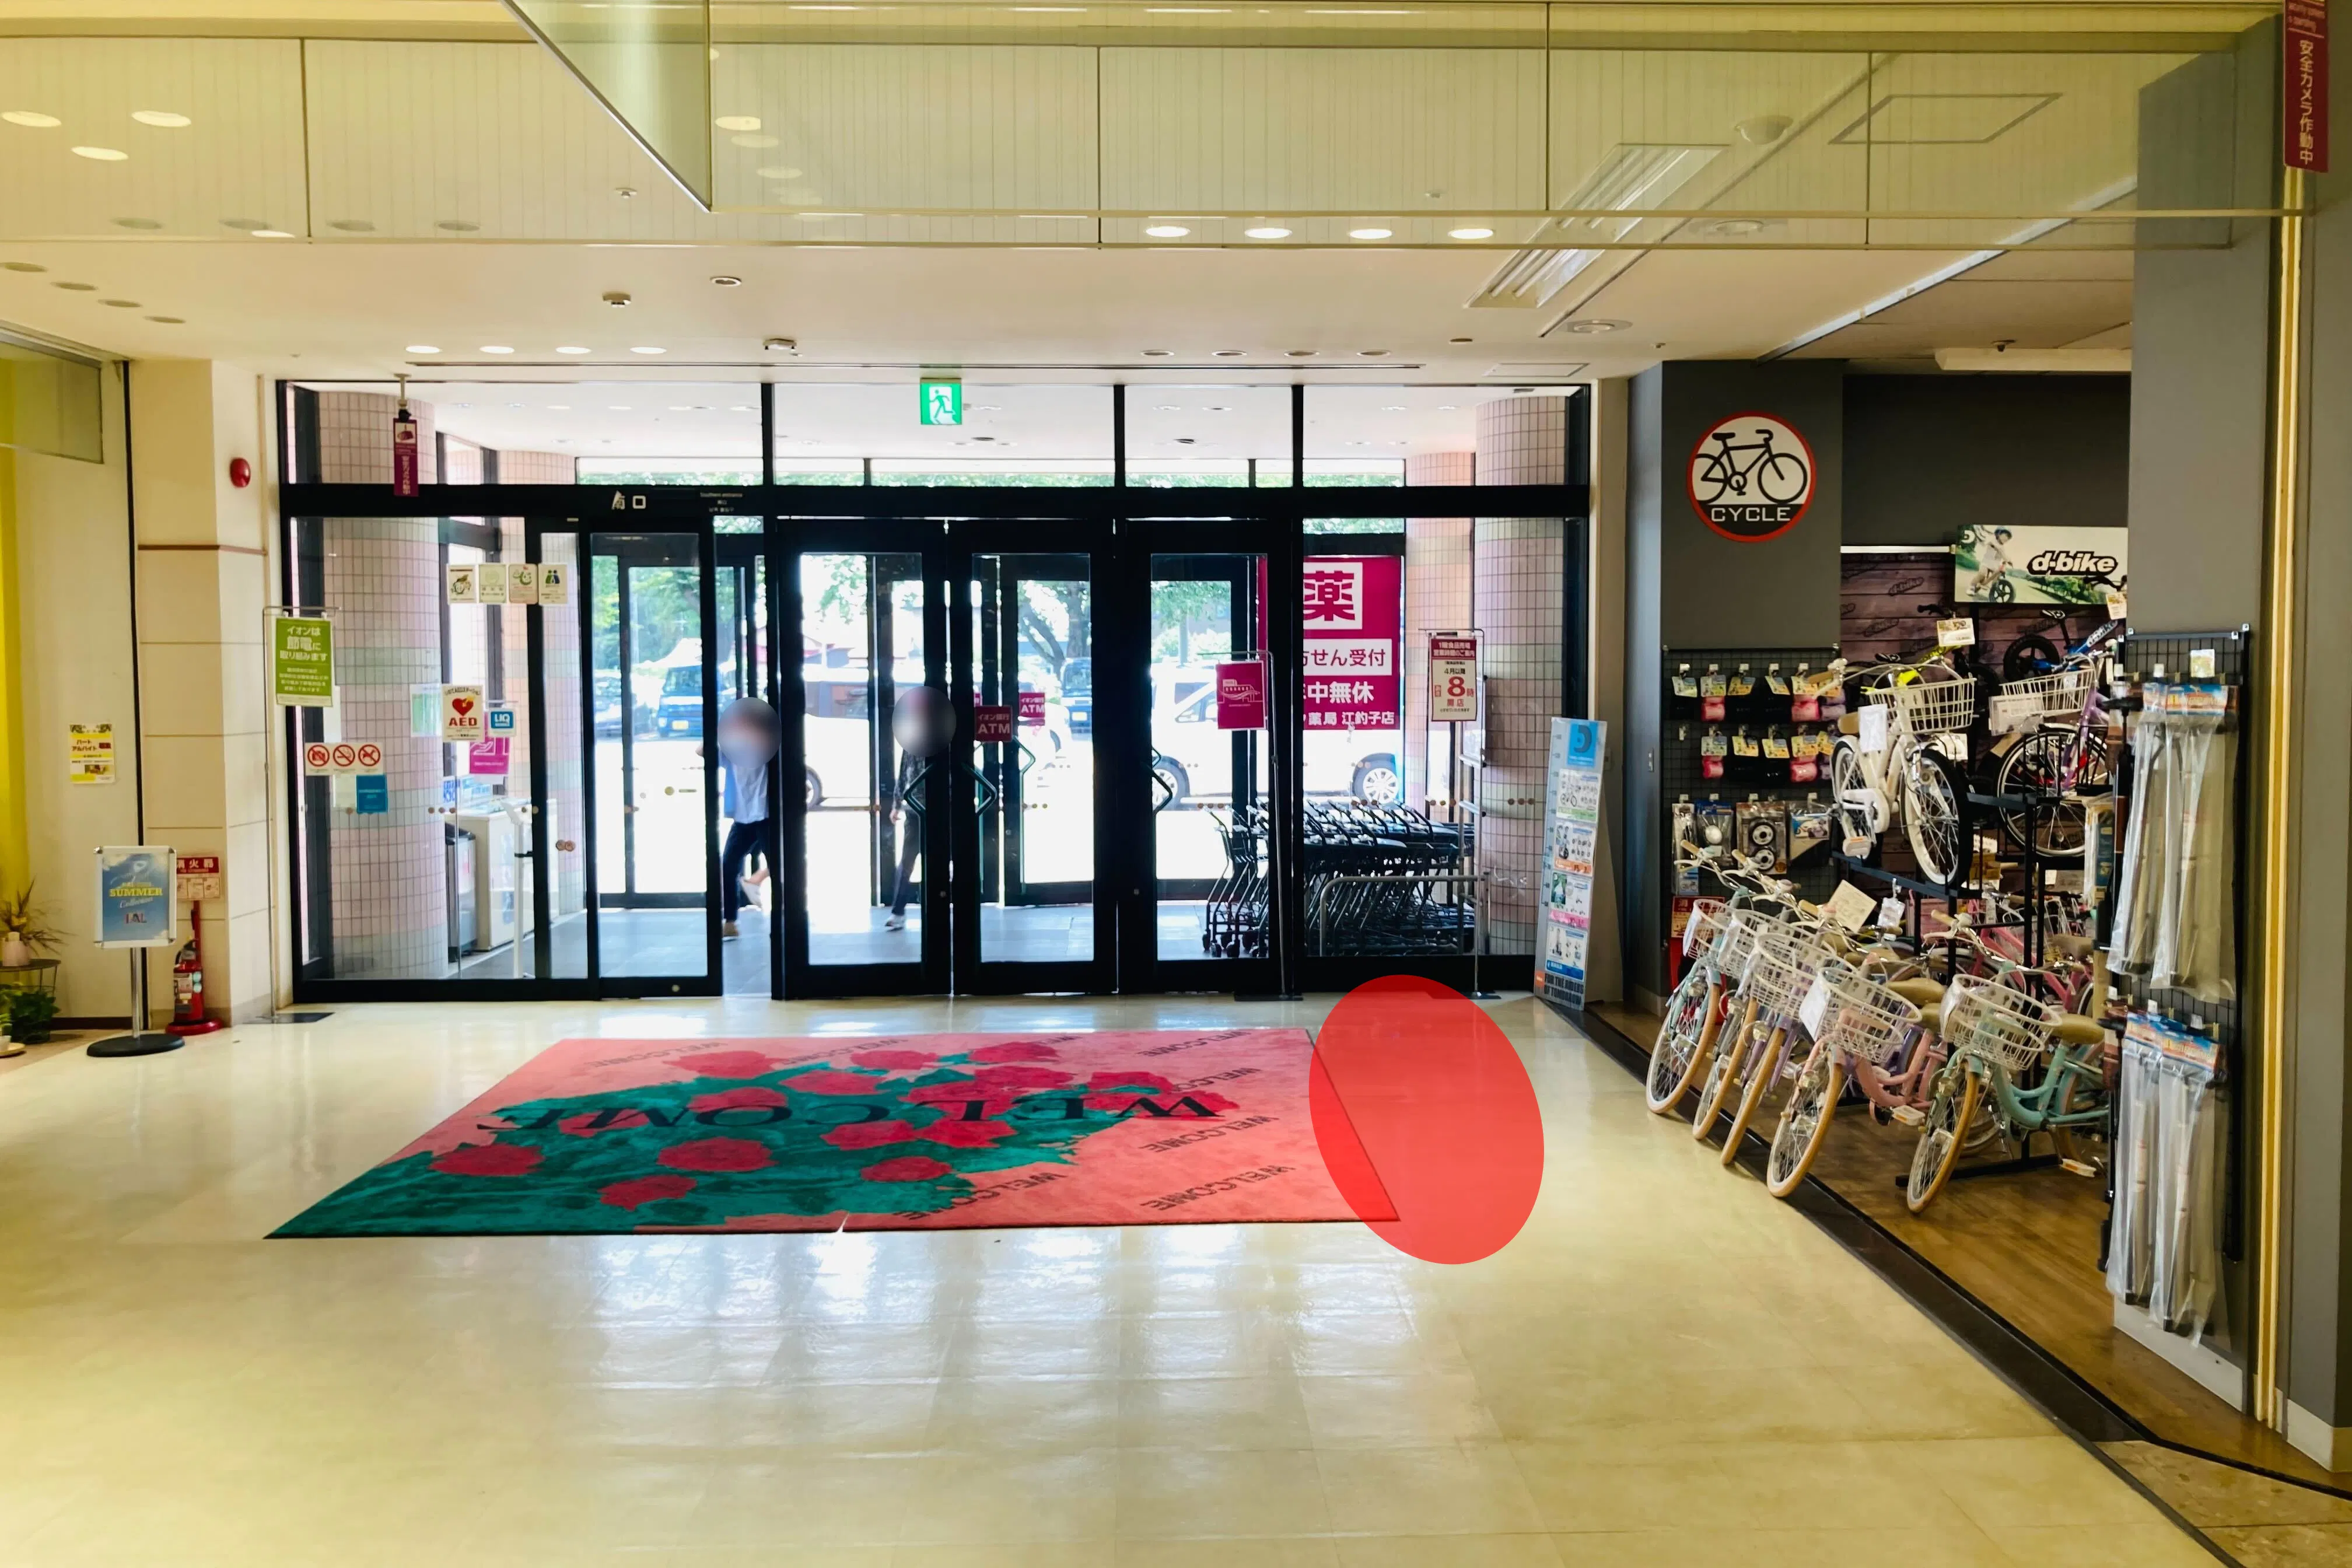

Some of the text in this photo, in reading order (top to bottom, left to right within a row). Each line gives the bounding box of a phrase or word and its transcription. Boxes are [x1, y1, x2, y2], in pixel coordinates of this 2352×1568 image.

[2300, 40, 2315, 164] 安全カメラ作動中
[1711, 507, 1791, 522] CYCLE
[2031, 551, 2116, 573] d-bike
[1303, 570, 1356, 622] 薬
[287, 625, 321, 636] イオンは
[1303, 681, 1375, 704] 中無休
[978, 713, 1010, 721] イオン銀行
[1021, 704, 1044, 713] ATM
[449, 717, 477, 727] AED
[978, 723, 1010, 734] ATM
[108, 887, 164, 898] SUMMER
[1137, 1031, 1251, 1056] WELCOME
[1172, 1068, 1264, 1092] WELCO
[477, 1096, 1225, 1130] WELCOME
[1138, 1115, 1279, 1153] WELCOME
[1140, 1165, 1296, 1210] WELCOME
